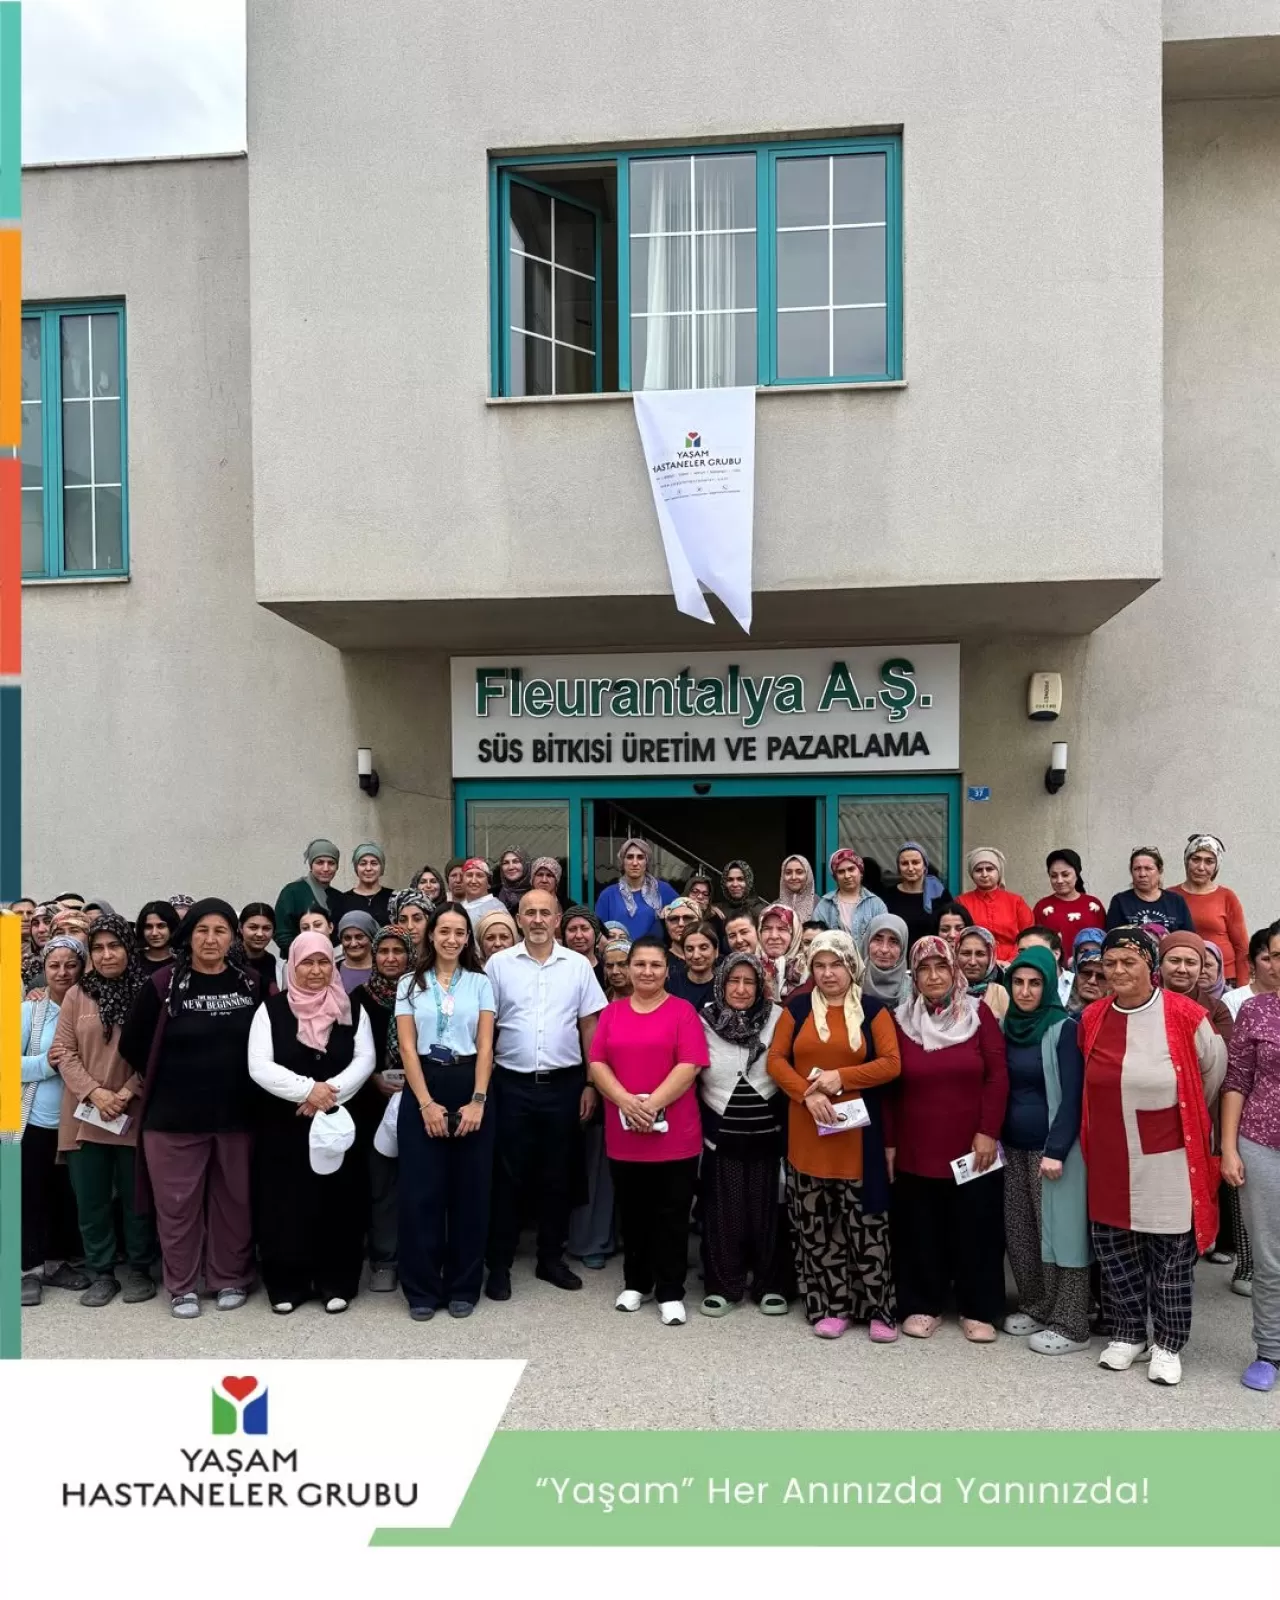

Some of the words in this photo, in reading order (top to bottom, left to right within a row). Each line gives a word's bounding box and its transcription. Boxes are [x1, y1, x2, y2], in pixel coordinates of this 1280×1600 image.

[676, 450, 709, 459] YAŞAM
[708, 457, 742, 466] GRUBU
[475, 664, 806, 728] Fleurantalya
[817, 657, 933, 723] A.Ş.
[478, 732, 523, 763] SÜS
[532, 732, 612, 763] BİTKISİ
[622, 731, 716, 763] ÜRETİM
[724, 737, 757, 761] VE
[767, 731, 931, 761] PAZARLAMA
[182, 1000, 203, 1009] NEW
